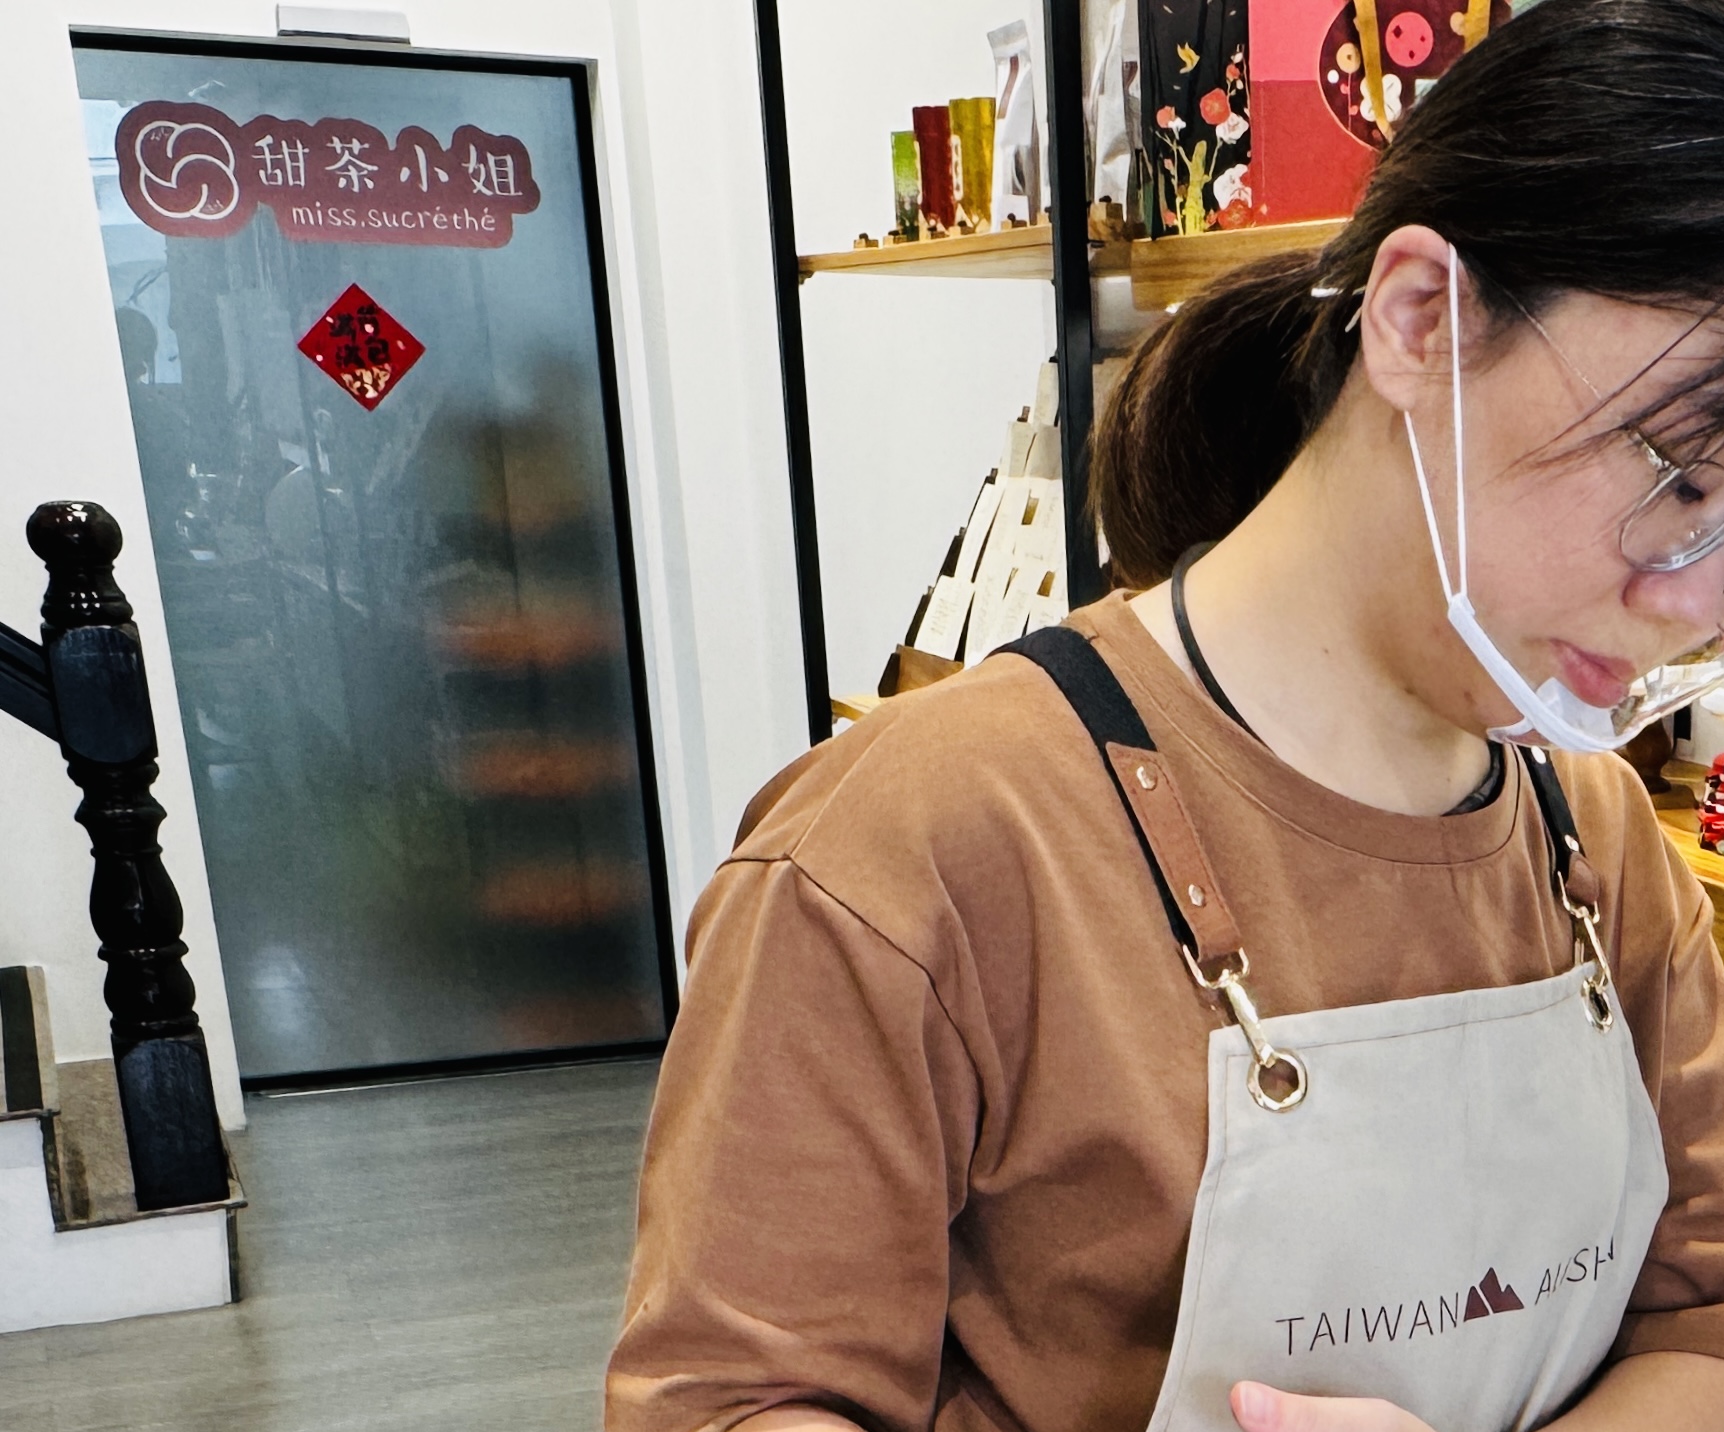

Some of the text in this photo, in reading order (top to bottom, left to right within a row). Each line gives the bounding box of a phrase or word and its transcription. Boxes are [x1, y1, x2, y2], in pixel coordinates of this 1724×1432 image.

[252, 133, 522, 197] 甜茶小姐
[292, 201, 496, 231] miss.sucréthé
[1275, 1292, 1460, 1356] TAIWAN
